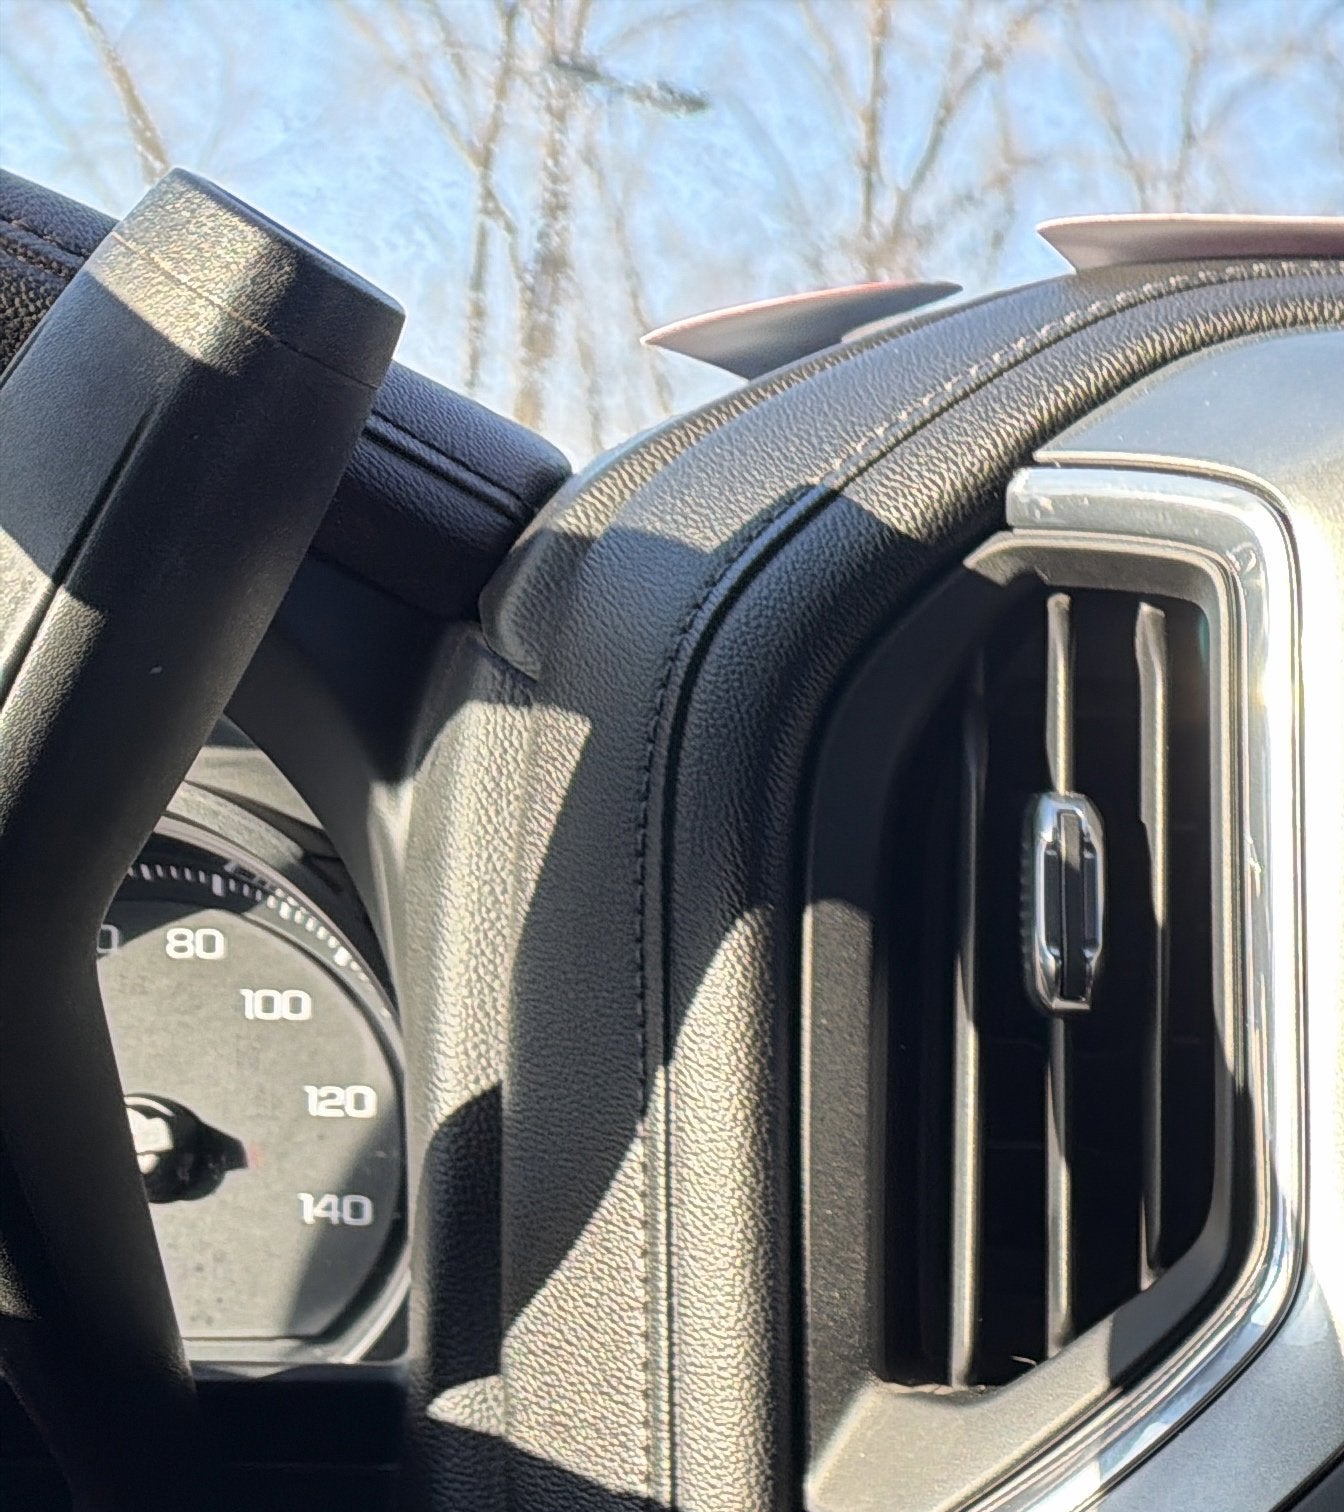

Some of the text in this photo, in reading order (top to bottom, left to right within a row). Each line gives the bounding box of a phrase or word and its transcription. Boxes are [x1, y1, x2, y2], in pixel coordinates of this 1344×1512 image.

[165, 927, 225, 960] 80
[240, 988, 312, 1021] 100
[303, 1084, 378, 1118] 120
[299, 1192, 374, 1226] 140
